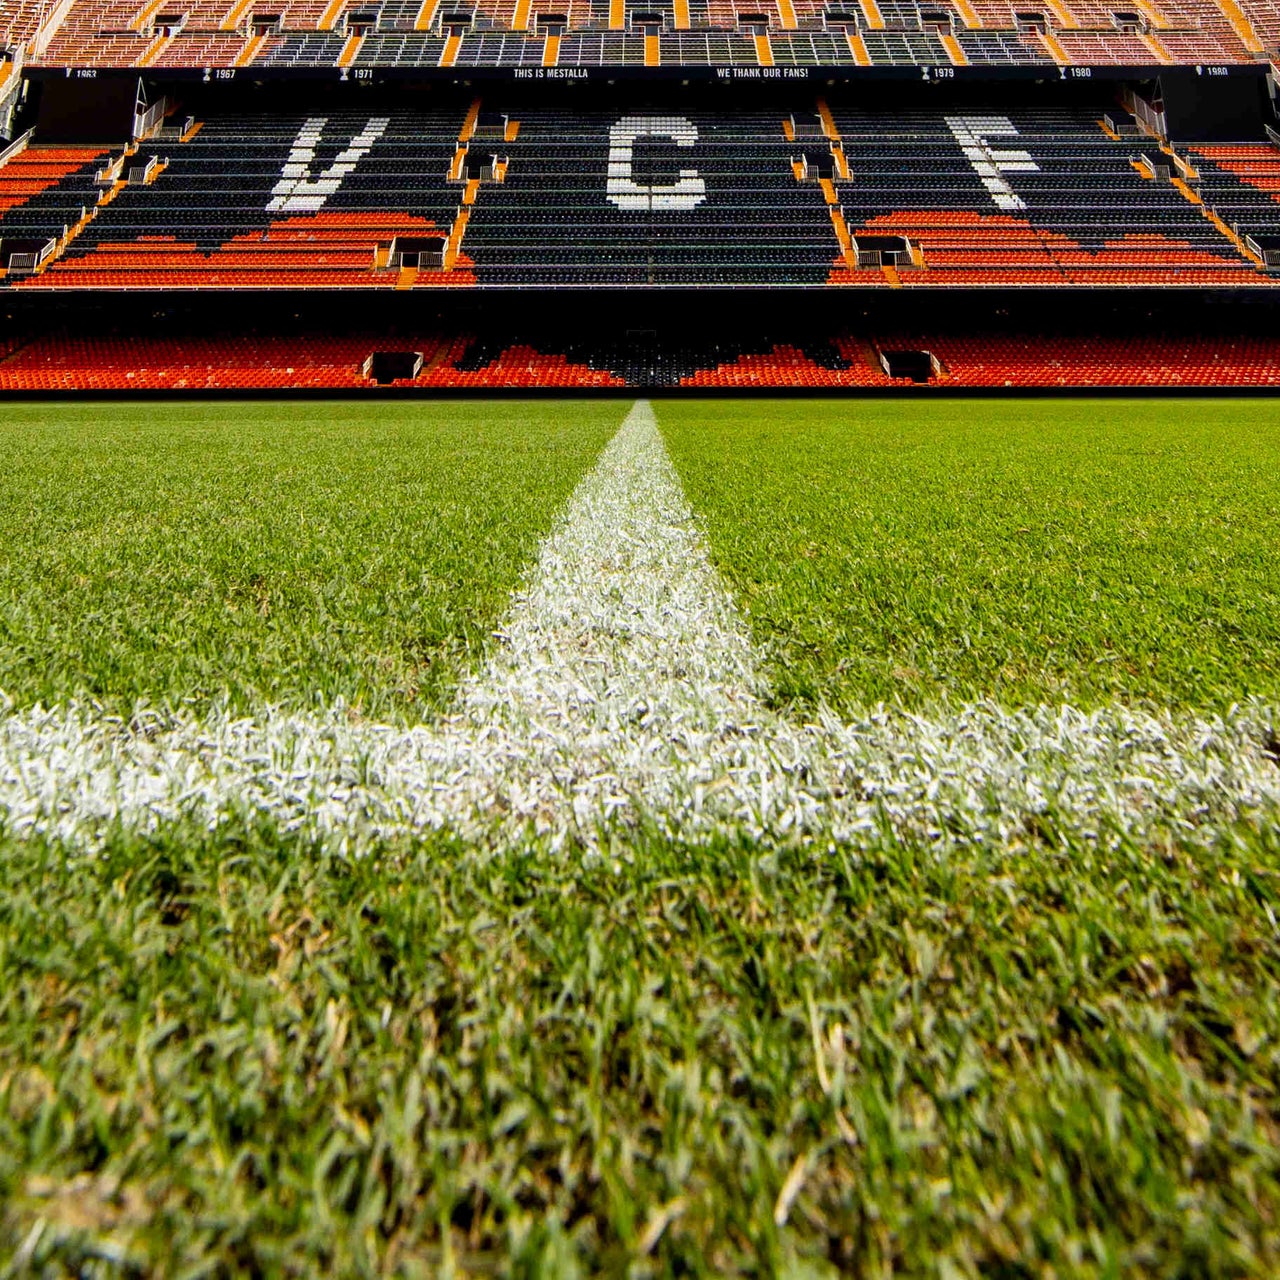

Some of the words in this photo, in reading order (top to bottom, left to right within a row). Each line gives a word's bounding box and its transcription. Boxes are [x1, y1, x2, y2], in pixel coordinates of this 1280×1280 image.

[215, 69, 235, 79] 1967
[354, 69, 373, 79] 1971
[514, 69, 532, 78] THIS
[536, 69, 544, 78] IS
[547, 69, 588, 78] MESTALLA
[717, 68, 730, 77] WE
[733, 68, 760, 77] THANK
[764, 68, 781, 77] OUR
[784, 68, 808, 77] FANS!
[934, 68, 954, 78] 1979
[1071, 67, 1091, 77] 1980
